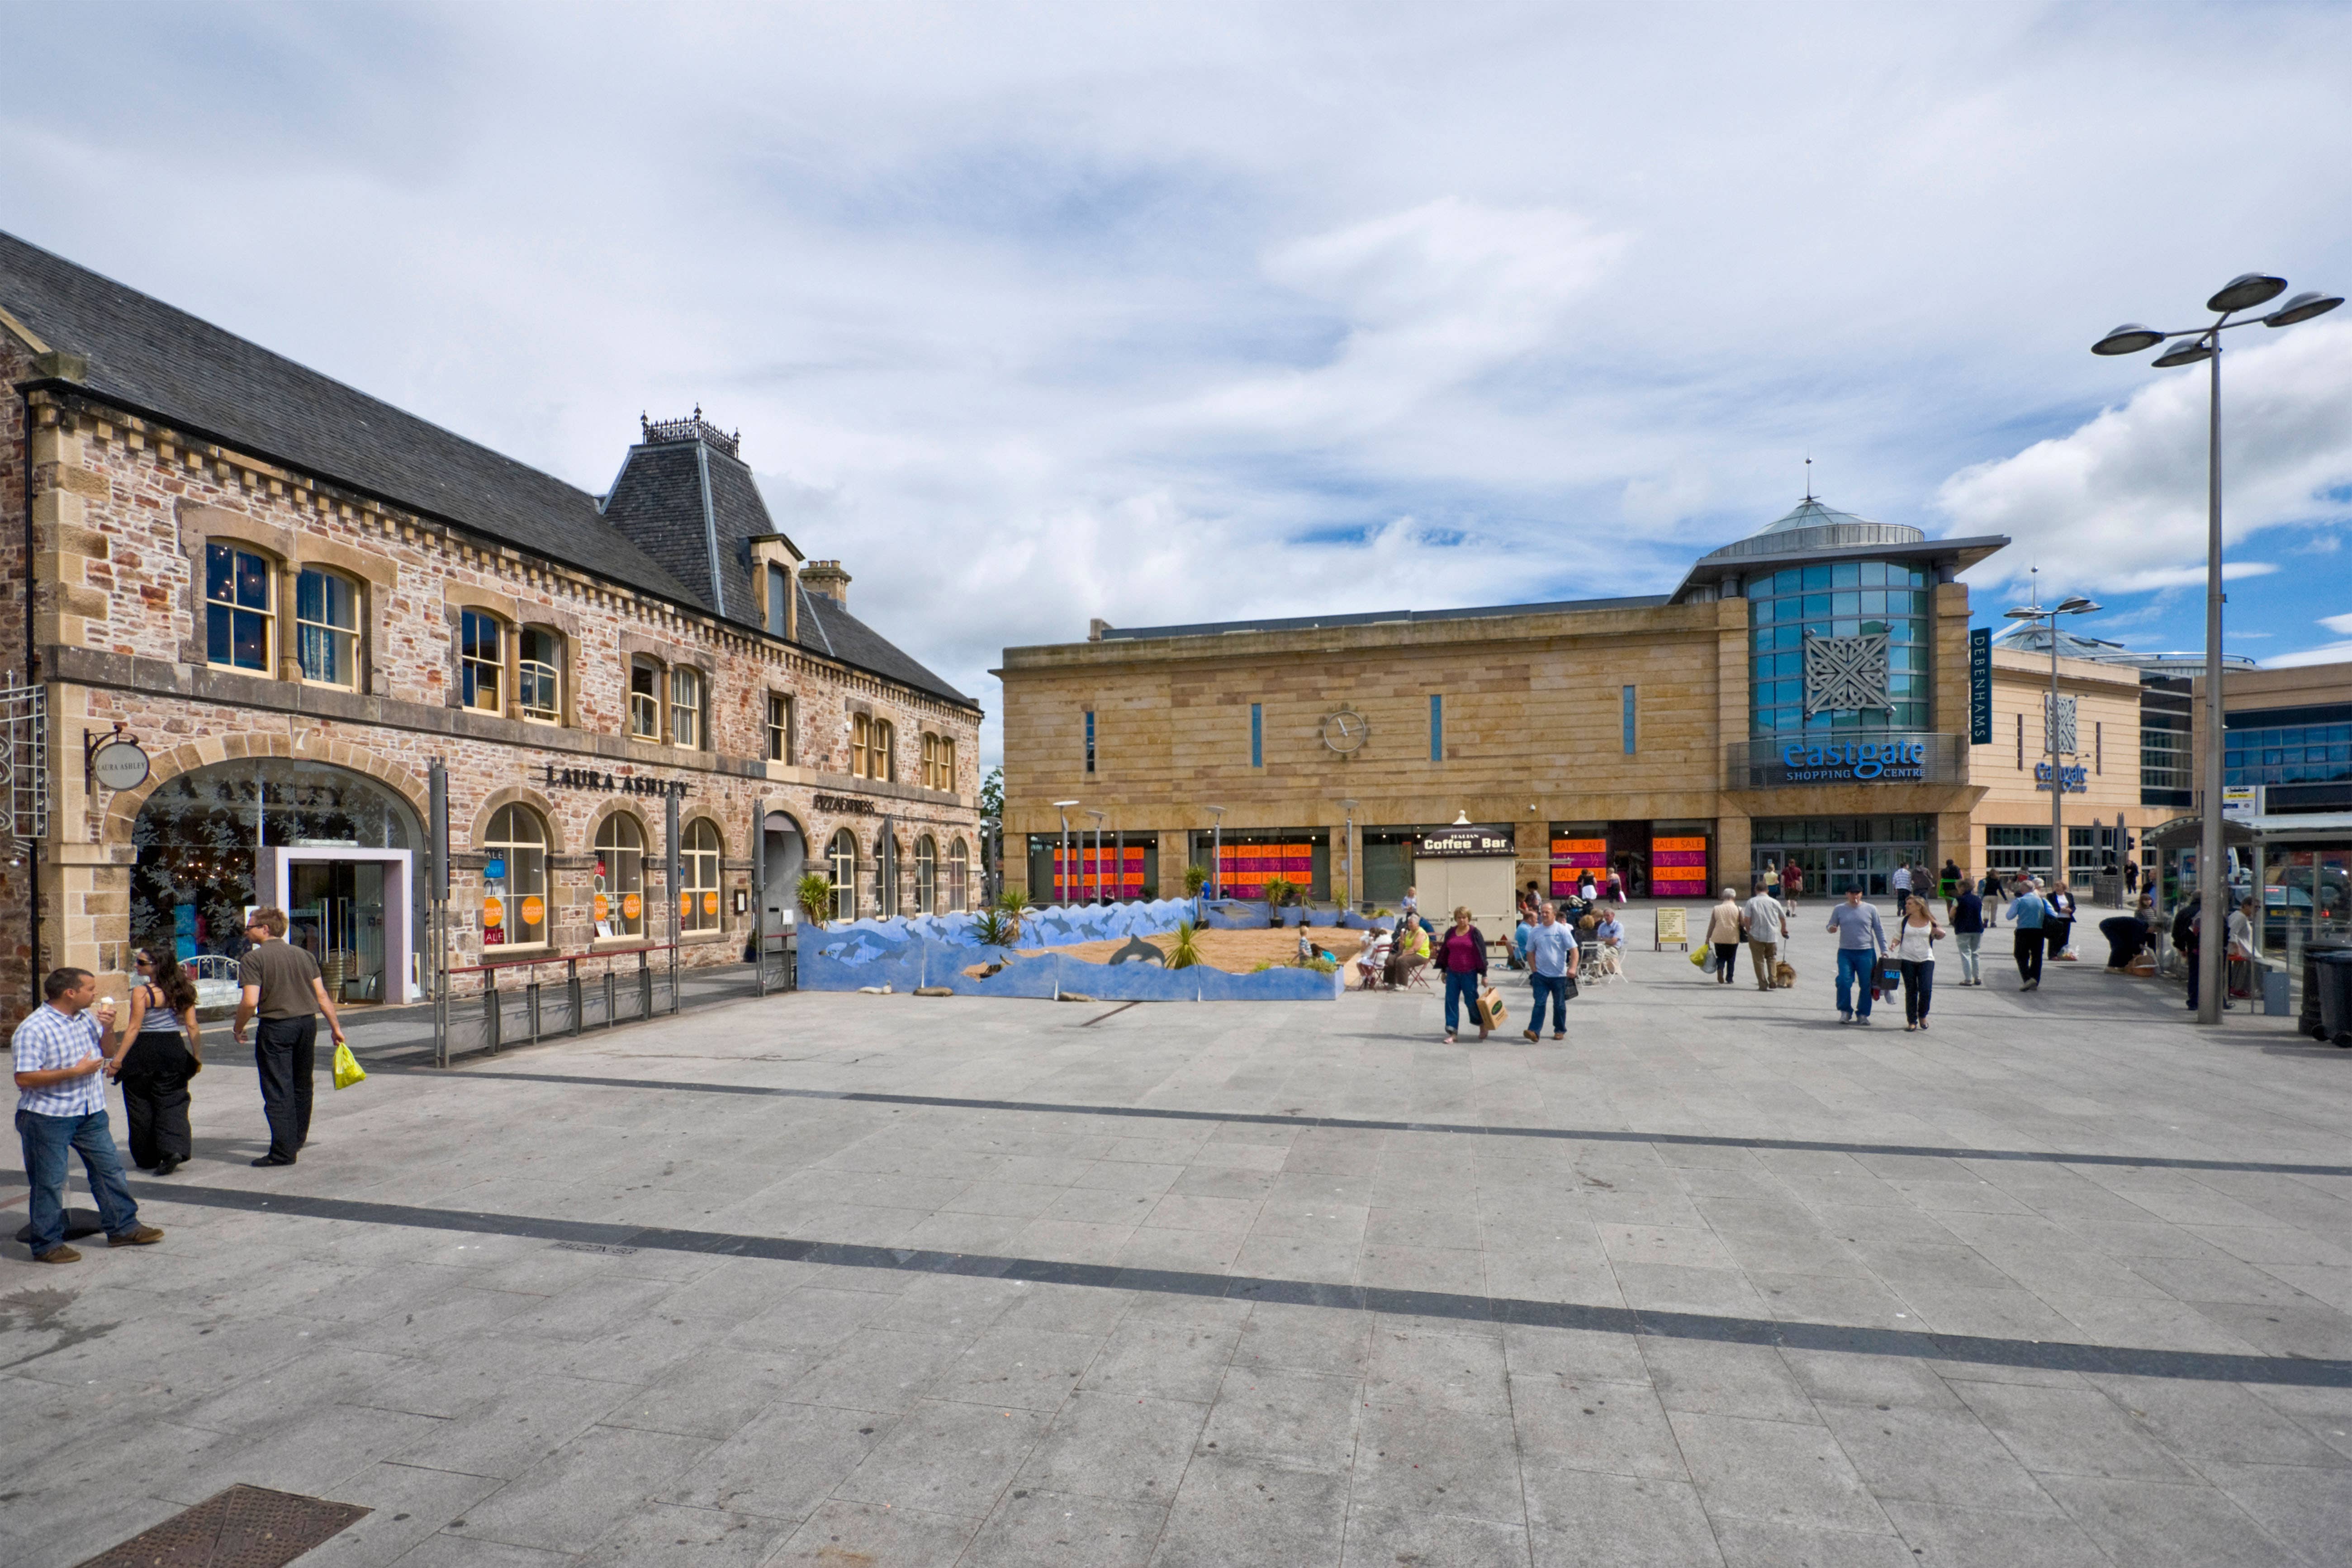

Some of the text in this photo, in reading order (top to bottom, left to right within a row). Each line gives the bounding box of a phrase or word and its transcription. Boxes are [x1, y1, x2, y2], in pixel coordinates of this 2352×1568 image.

[1974, 636, 1986, 737] DEBENHAMS
[294, 728, 309, 750] 7
[1783, 739, 1925, 778] eastgate
[1787, 768, 1925, 781] SHOPPING CENTRE
[545, 765, 689, 800] LAURA ASHLEY
[1425, 838, 1507, 849] Coffee Bar
[1556, 842, 1602, 850] SALE SALE
[1654, 839, 1702, 848] SALE SALE
[1125, 849, 1143, 857] SALE
[1219, 847, 1234, 856] ALE
[1240, 847, 1259, 855] SALE
[1290, 846, 1309, 854] SALE
[1220, 873, 1234, 882] ALE
[1241, 873, 1260, 882] SALE
[1290, 872, 1309, 881] SALE
[1556, 870, 1576, 879] SALE
[1654, 869, 1702, 878] SALE SALE
[1125, 875, 1143, 883] SALE
[485, 933, 503, 942] ALE
